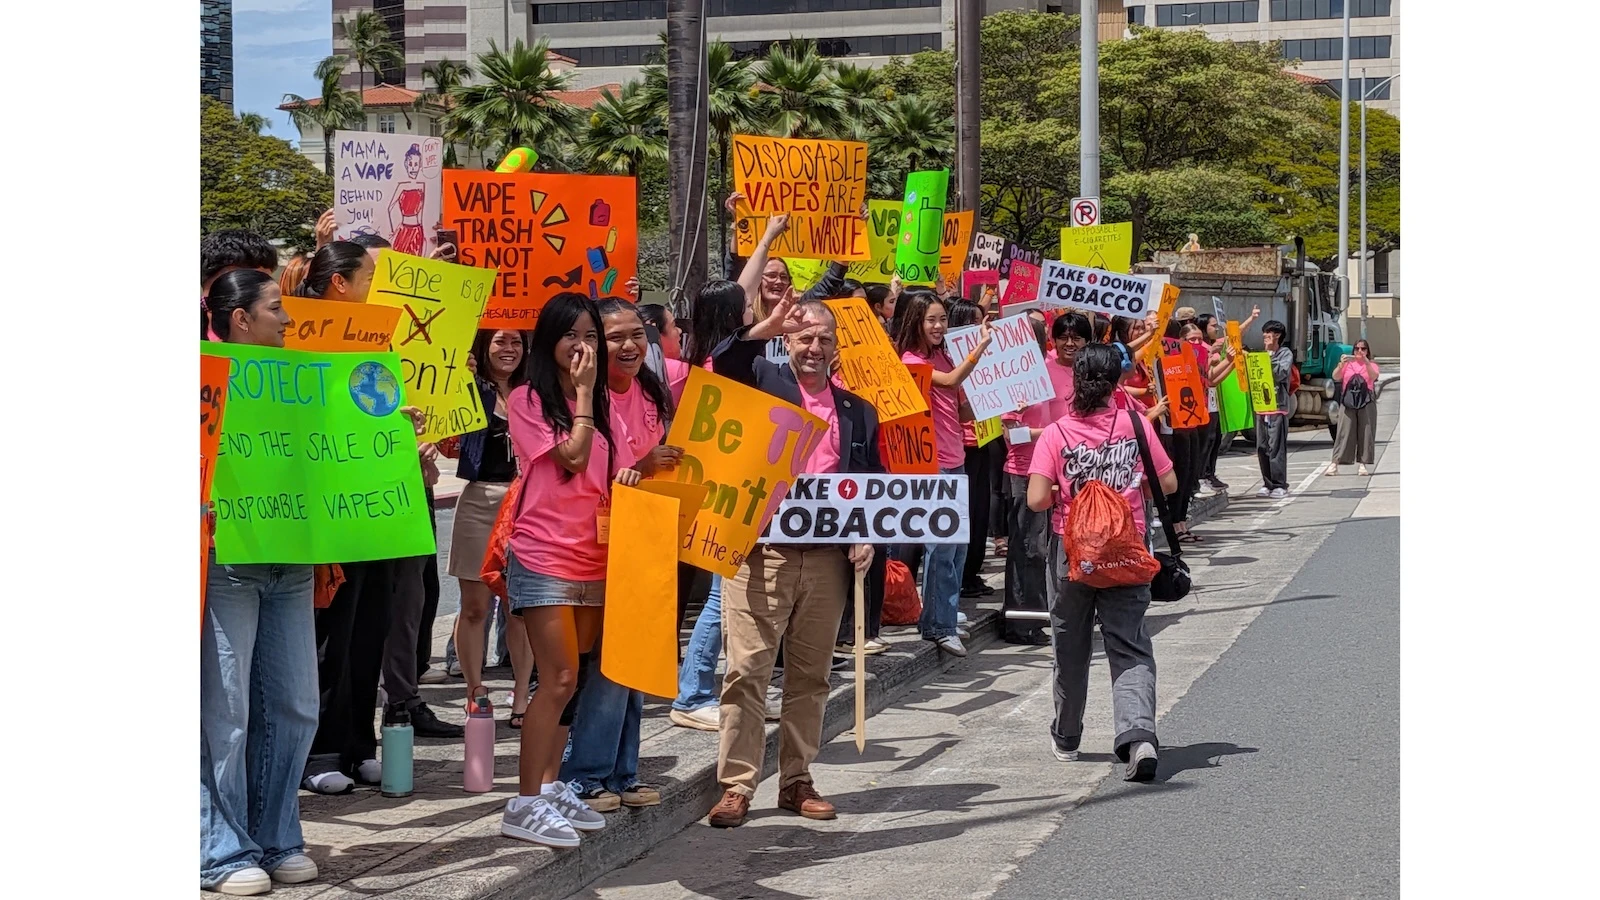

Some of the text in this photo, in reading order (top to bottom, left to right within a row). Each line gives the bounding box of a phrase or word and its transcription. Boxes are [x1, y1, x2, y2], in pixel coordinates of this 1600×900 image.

[341, 139, 389, 160] MAMA,
[735, 140, 864, 182] DISPOSABLE
[341, 161, 395, 182] A VAPE
[340, 189, 383, 205] BEHIND
[453, 182, 516, 215] VAPE
[745, 181, 858, 213] VAPES ARE
[453, 218, 534, 244] TRASH
[808, 215, 864, 256] WASTE
[977, 234, 1003, 255] Quit
[1072, 225, 1119, 236] DISPOSABLE
[484, 247, 534, 270] NOT
[387, 256, 443, 297] Vape
[1049, 265, 1086, 283] TAKE
[1099, 275, 1147, 295] DOWN
[1046, 281, 1144, 313] TOBACCO
[995, 317, 1036, 352] DOWN
[228, 356, 332, 406] ROTECT
[689, 383, 743, 454] Be
[869, 386, 918, 421] KEIKI
[971, 389, 1004, 416] PASS
[259, 431, 294, 458] THE
[306, 430, 364, 463] SALE
[373, 429, 401, 458] OF
[218, 481, 415, 523] DISPOSABLE VAPES!!
[865, 478, 959, 500] DOWN
[701, 525, 727, 562] the
